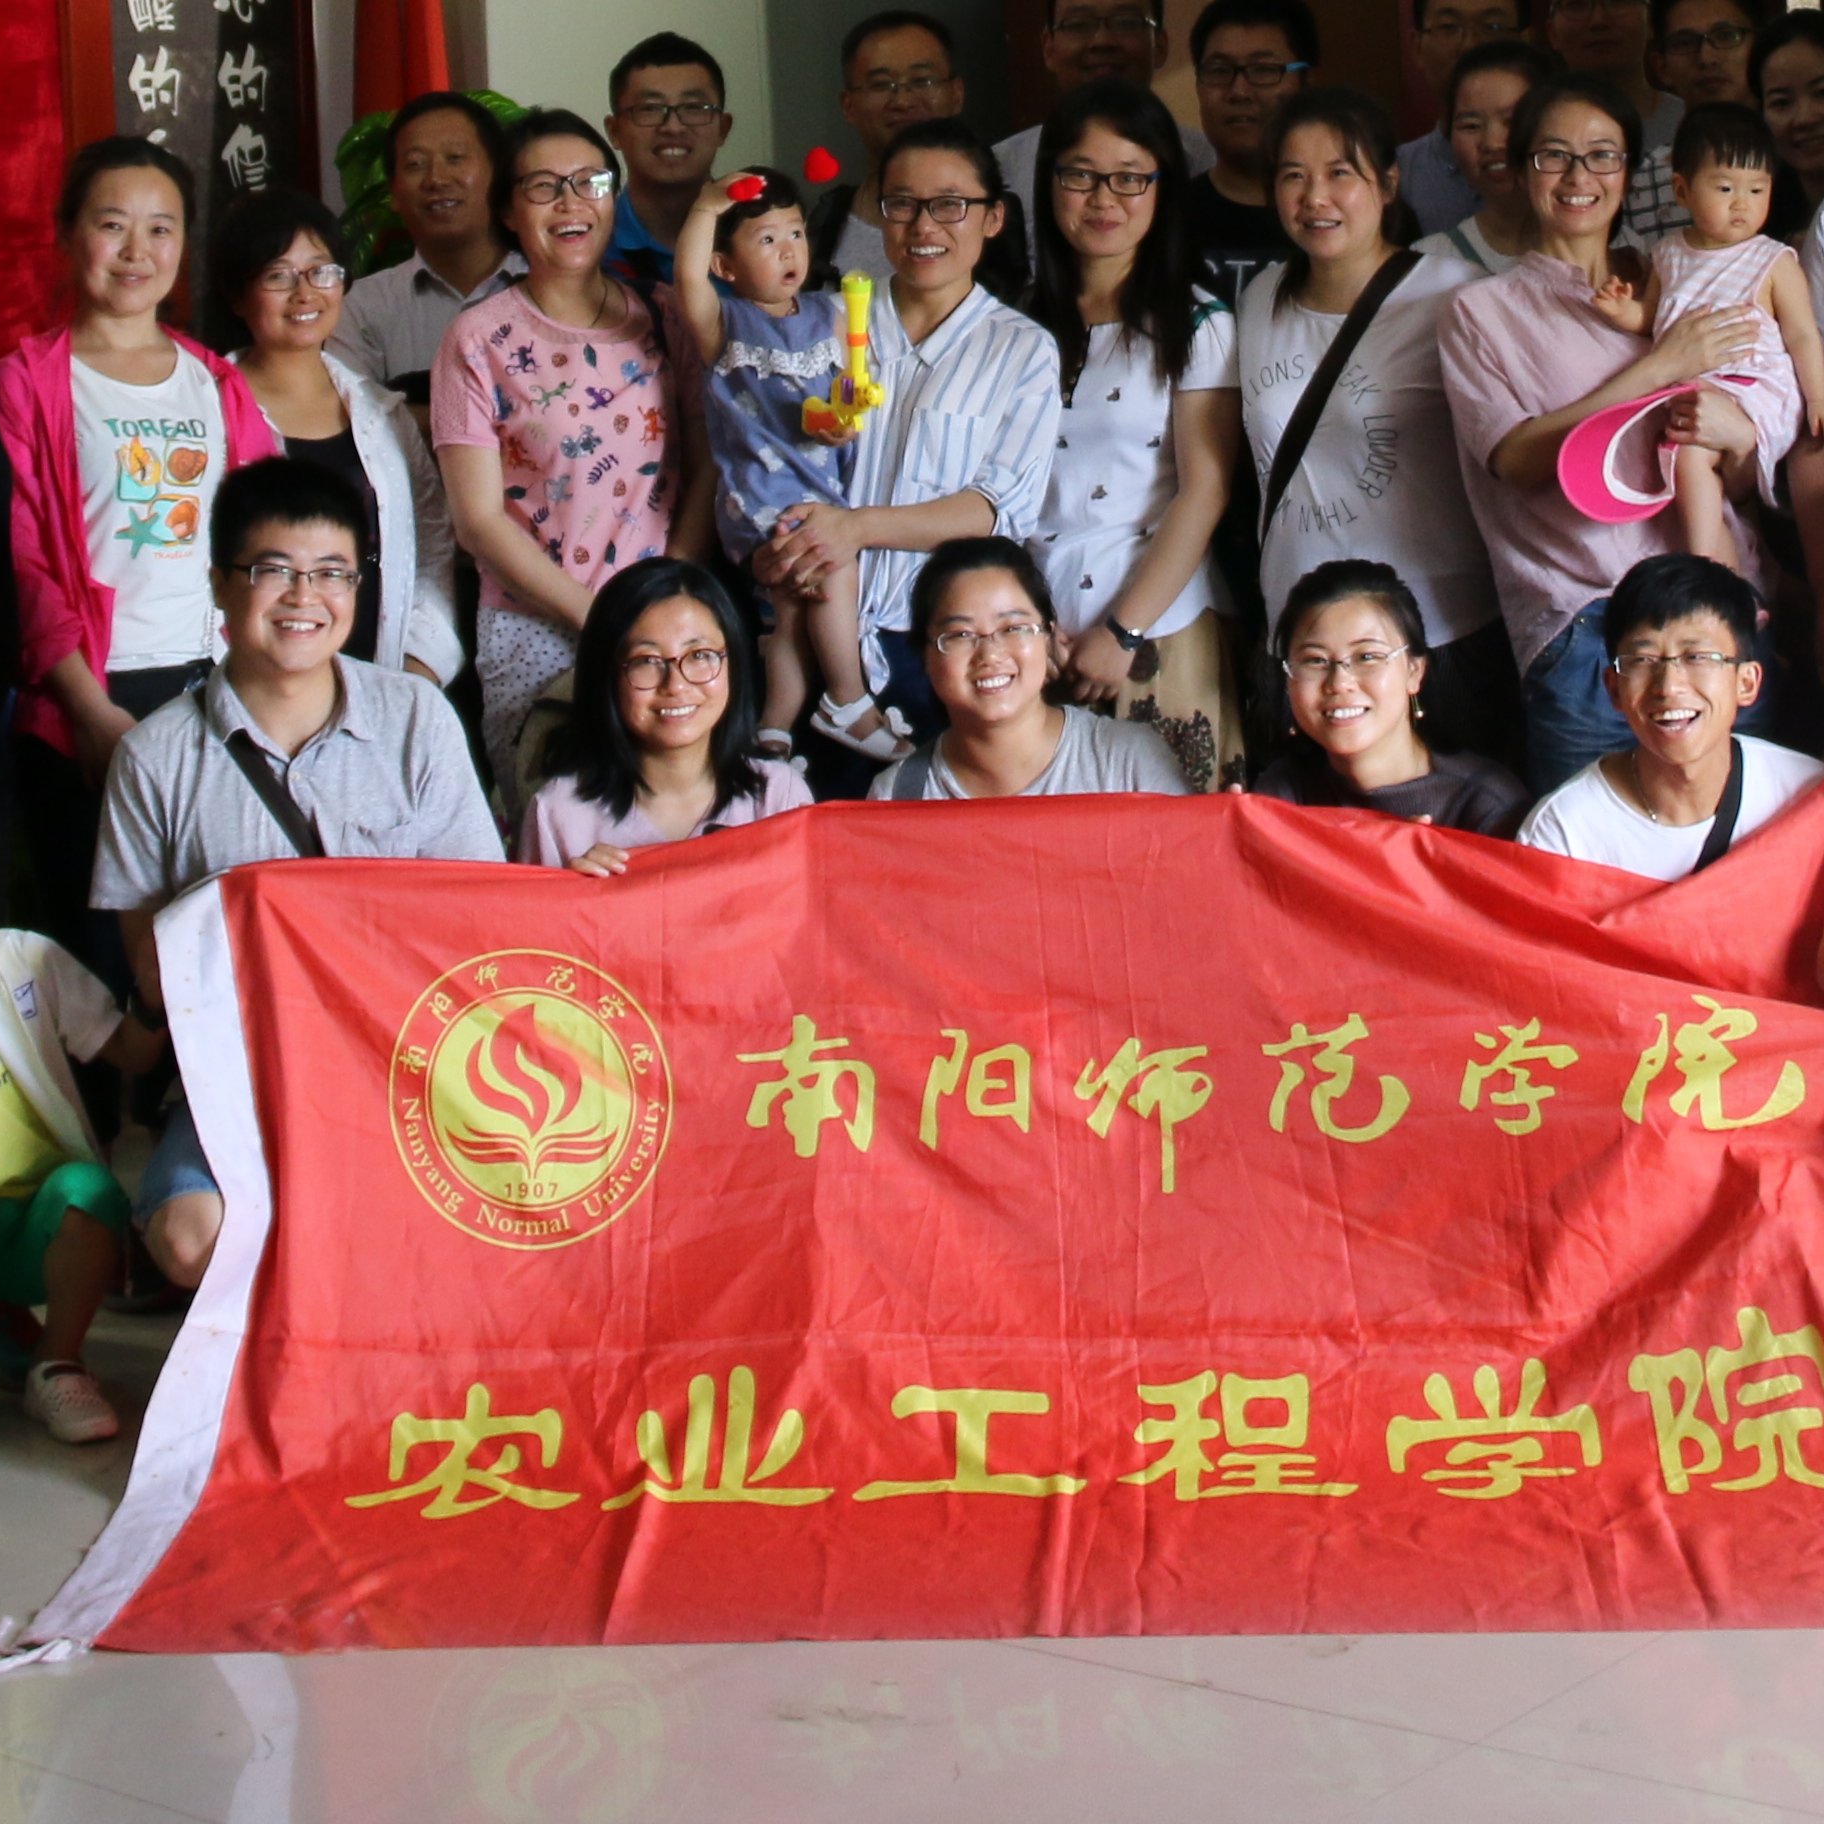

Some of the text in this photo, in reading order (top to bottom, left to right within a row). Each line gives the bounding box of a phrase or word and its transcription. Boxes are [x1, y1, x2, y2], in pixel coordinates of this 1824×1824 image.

[103, 418, 206, 438] TOREAD
[1356, 415, 1398, 499] LOUDER
[1298, 497, 1358, 532] THAN
[736, 992, 1806, 1194] 南阳师范学院
[402, 1097, 665, 1236] Nanyang Normal University
[504, 1182, 560, 1199] 1907
